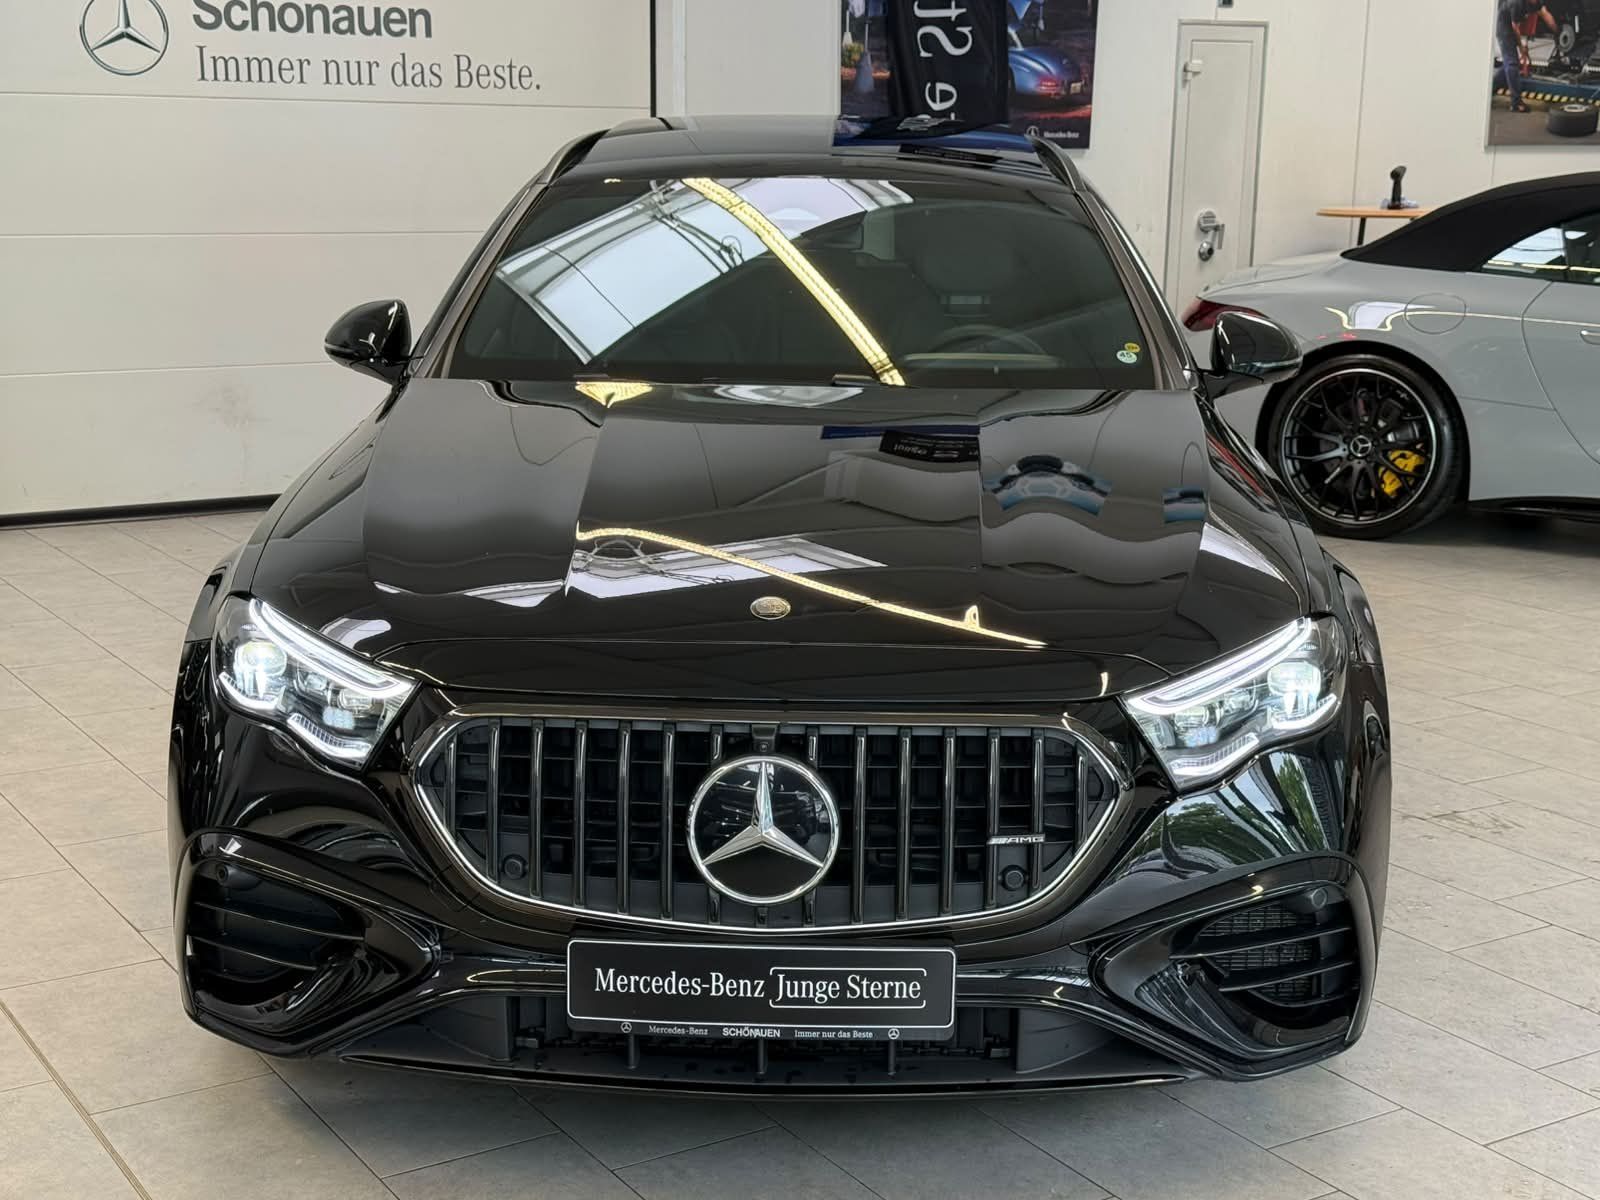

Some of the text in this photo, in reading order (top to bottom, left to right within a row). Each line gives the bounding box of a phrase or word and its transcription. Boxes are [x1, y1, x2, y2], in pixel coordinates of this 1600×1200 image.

[195, 45, 541, 90] Immer nur das Beste.
[594, 967, 921, 1004] Mercedes-Benz Junge Sterne
[649, 1025, 874, 1039] Mercedes-Benz SCHÖNAUEN Immer nur das Beste
